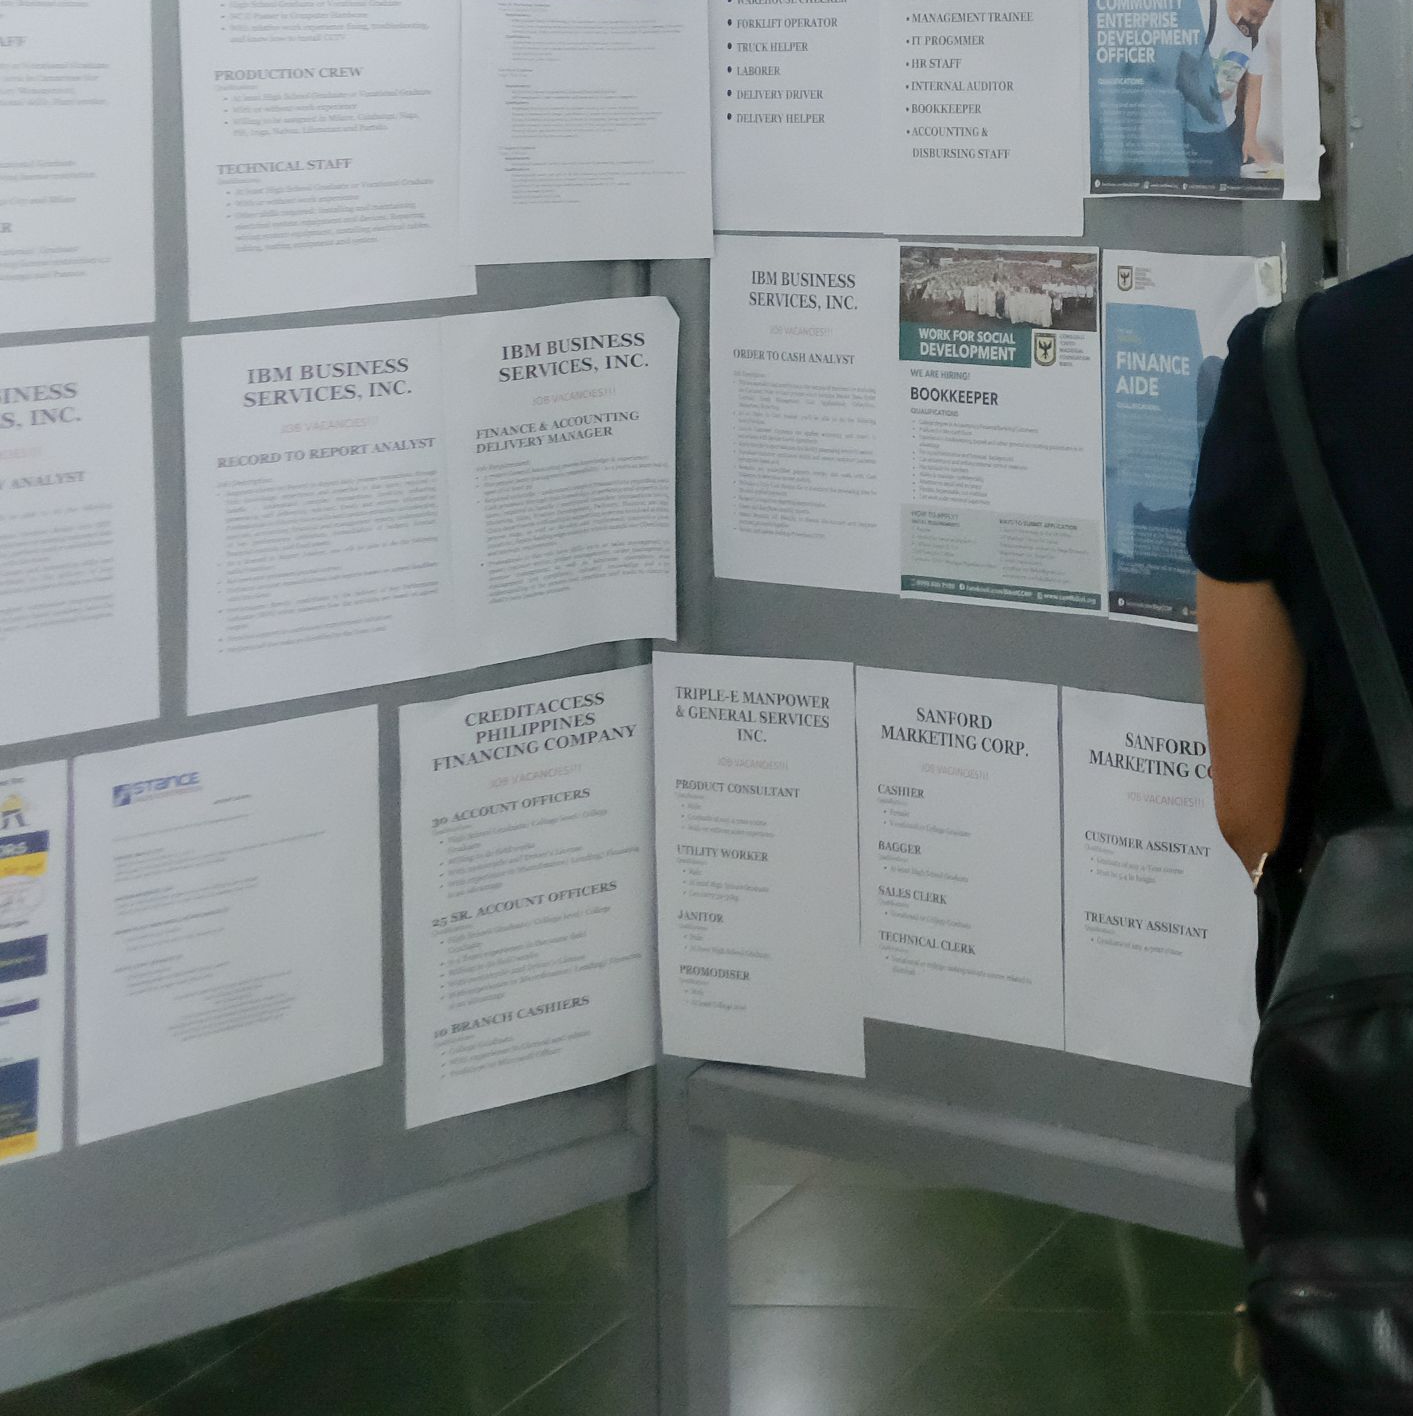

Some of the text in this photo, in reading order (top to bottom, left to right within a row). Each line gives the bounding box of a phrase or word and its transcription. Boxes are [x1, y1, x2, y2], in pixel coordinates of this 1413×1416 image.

[737, 17, 838, 28] FORKLIFT OPERATOR
[912, 12, 1033, 23] MANAGEMENT TRAINEE
[1097, 12, 1178, 28] ENTERPRISE
[737, 42, 808, 52] TRUCK HELPER
[912, 36, 985, 45] IT PROGMMER
[1097, 29, 1199, 46] DEVELOPMENT
[1097, 47, 1155, 63] OFFICER
[214, 67, 364, 81] PRODUCTION CREW
[737, 66, 780, 76] LABORER
[911, 81, 1013, 91] INTERNAL AUDITOR
[911, 104, 981, 114] BOOKKEEPER
[912, 148, 1010, 159] DISBURSING STAFF
[217, 158, 352, 175] TECHNICAL STAFF
[752, 271, 855, 289] IBM BUSINESS
[749, 292, 858, 310] SERVICES, INC.
[919, 328, 1016, 345] WORK FOR SOCIAL
[502, 332, 645, 361] IBM BUSINESS
[920, 342, 1016, 361] DEVELOPMENT
[247, 358, 409, 384] IBM BUSINESS
[499, 354, 648, 382] SERVICES, INC.
[1116, 351, 1190, 376] FINANCE
[243, 380, 412, 407] SERVICES, INC.
[1116, 375, 1159, 396] AIDE
[911, 387, 998, 406] BOOKKEEPER
[477, 423, 536, 439] FINANCE
[551, 410, 639, 430] ACCOUNTING
[477, 426, 612, 454] DELIVERY MANAGER
[218, 438, 436, 468] RECORD TO REPORT ANALYST
[676, 687, 830, 709] TRIPLE-E MANPOWER
[465, 692, 605, 726] CREDITACCESS
[676, 705, 829, 728] & GENERAL SERVICES
[916, 707, 992, 730] SANFORD
[476, 712, 596, 745] PHILIPPINES
[737, 728, 767, 743] INC.
[432, 724, 638, 772] FINANCING COMPANY
[881, 725, 1028, 757] MARKETING CORP.
[1125, 732, 1206, 756] SANFORD
[1089, 748, 1190, 778] MARKETING
[878, 784, 924, 799] CASHIER
[879, 841, 921, 855] BAGGER
[1085, 830, 1210, 857] CUSTOMER ASSISTANT
